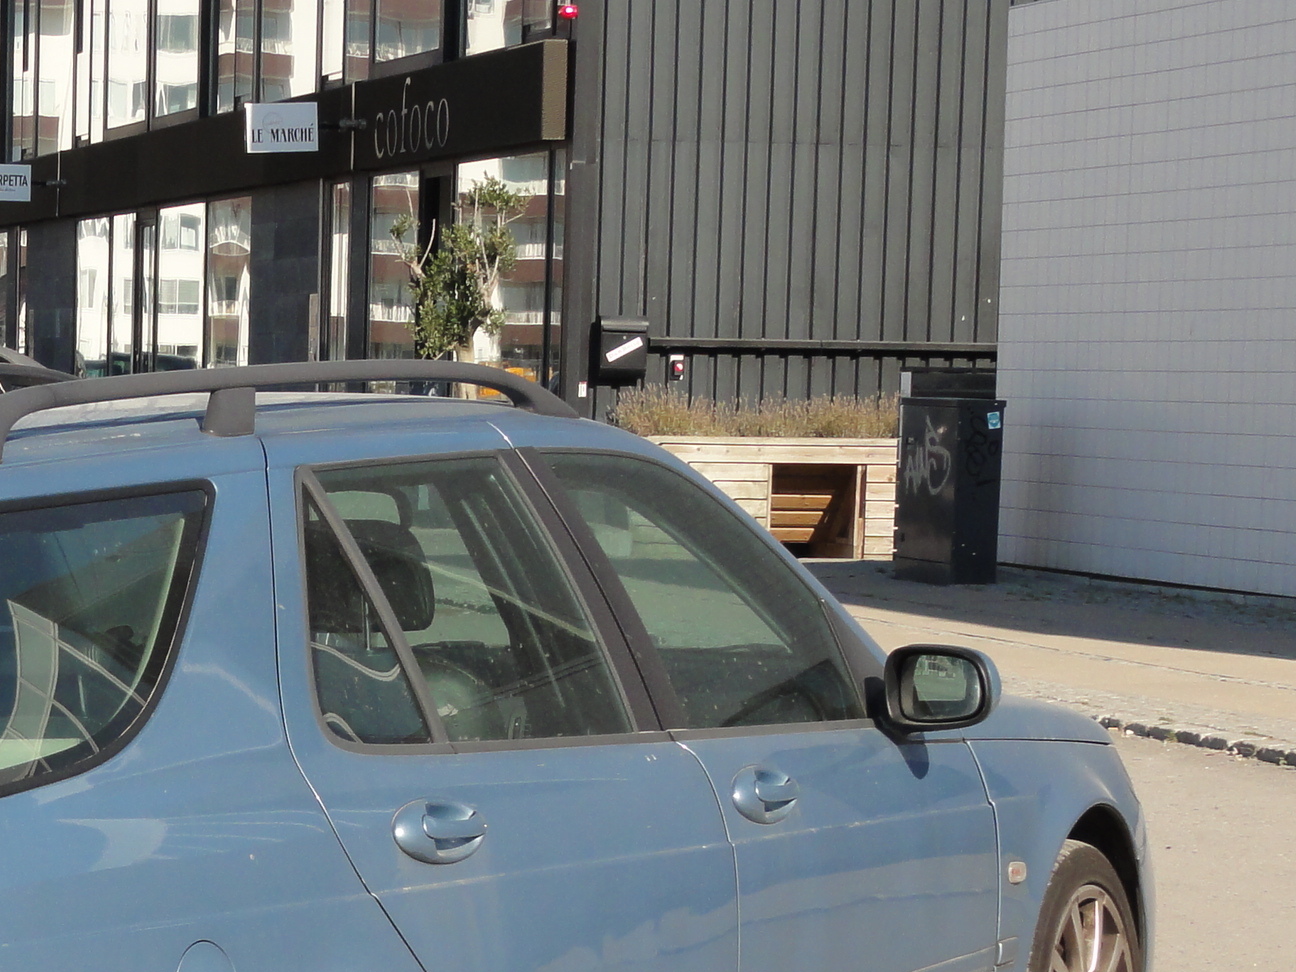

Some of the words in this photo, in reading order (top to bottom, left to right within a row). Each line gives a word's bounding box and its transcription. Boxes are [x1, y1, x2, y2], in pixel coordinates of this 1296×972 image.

[251, 128, 263, 143] LE
[270, 123, 315, 143] MARCHÉ
[374, 77, 450, 159] cofoco
